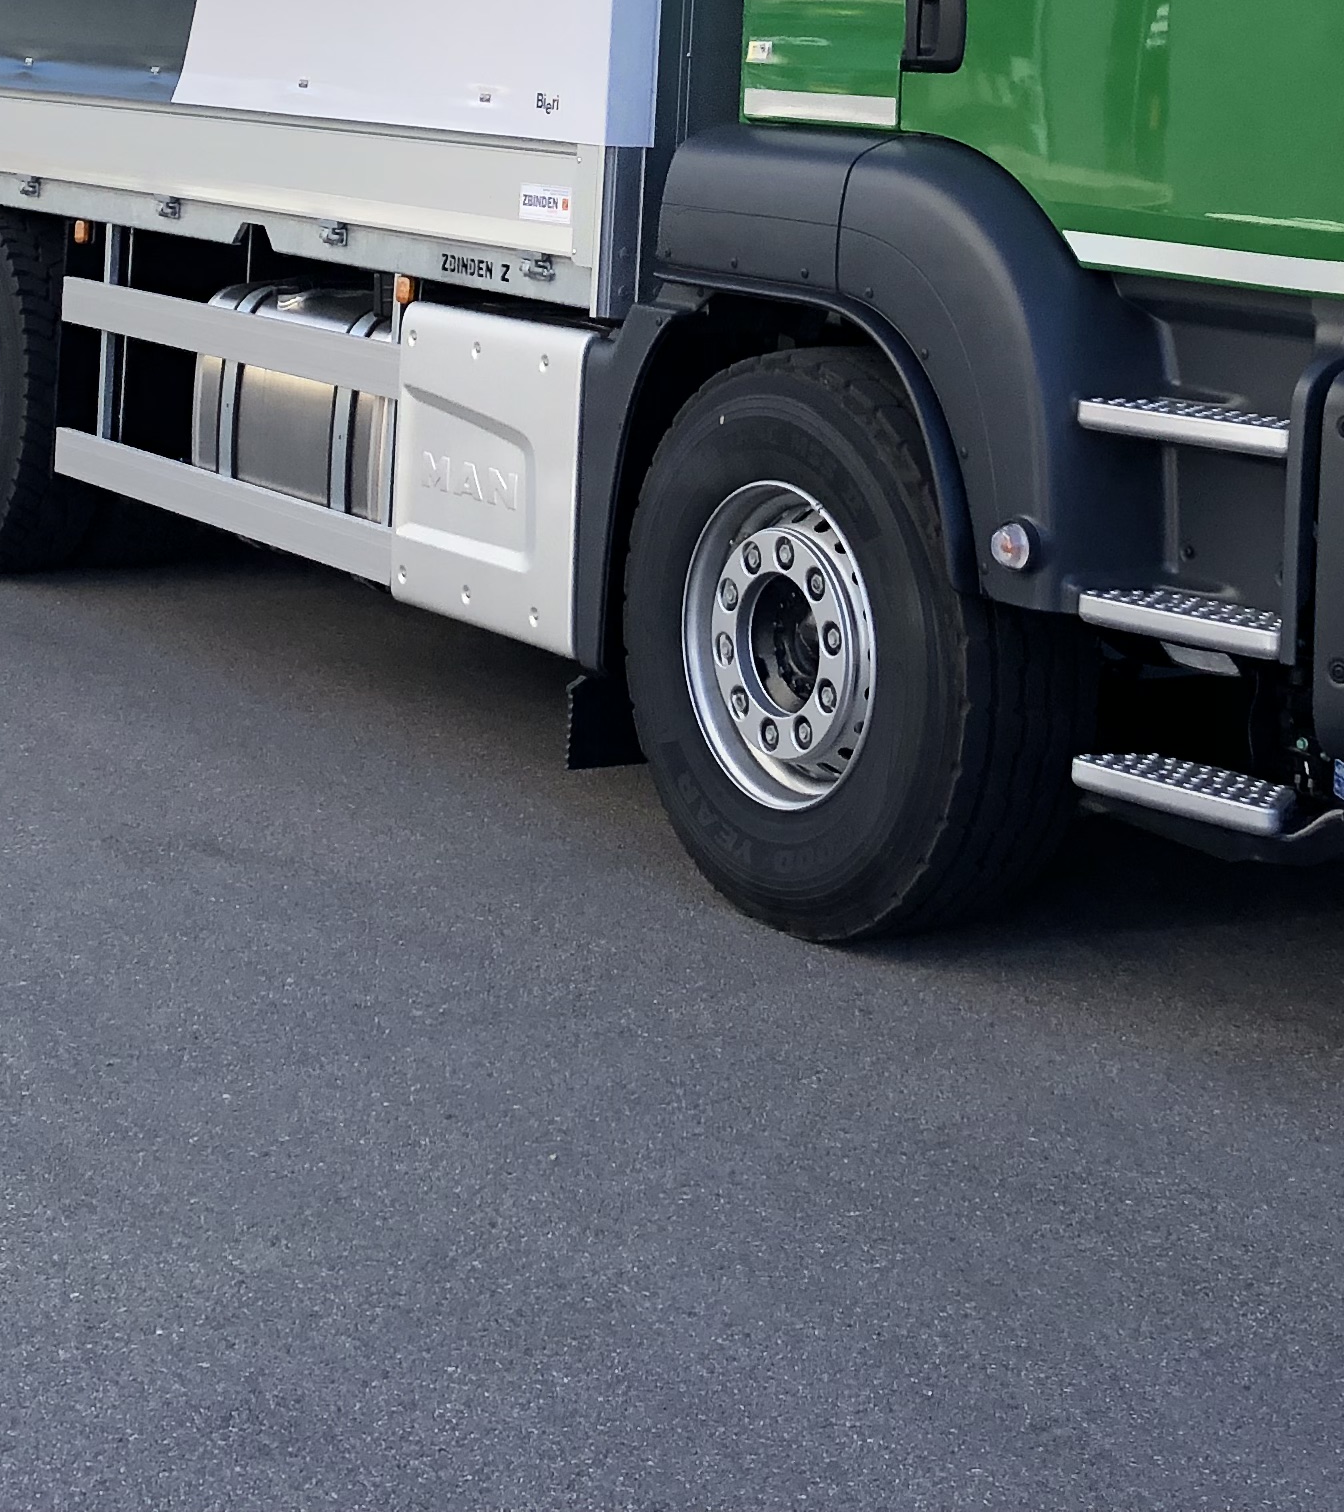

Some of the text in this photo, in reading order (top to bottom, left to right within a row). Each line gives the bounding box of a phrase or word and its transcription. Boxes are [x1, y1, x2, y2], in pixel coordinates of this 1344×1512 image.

[536, 92, 560, 115] Bieri
[441, 253, 511, 283] ZBINDEN Z
[421, 450, 518, 511] MAN
